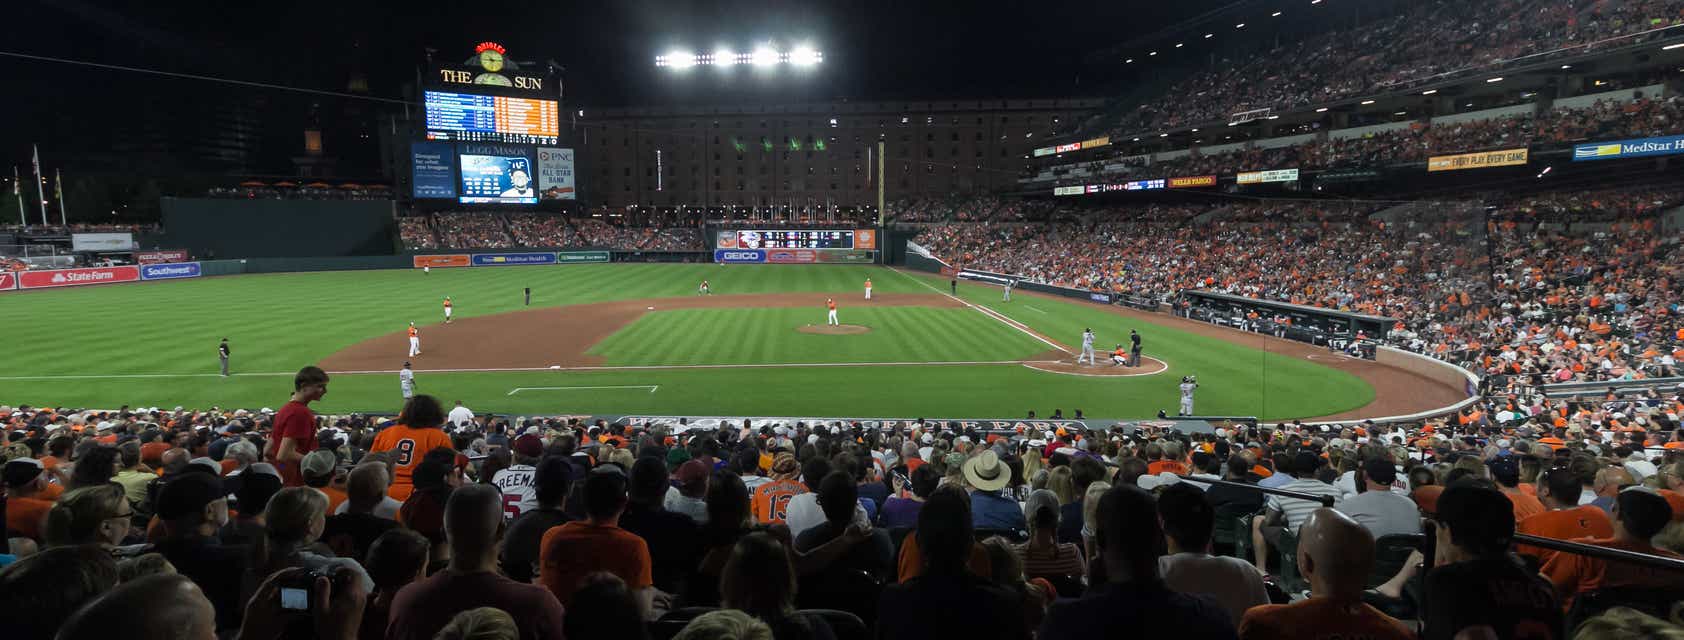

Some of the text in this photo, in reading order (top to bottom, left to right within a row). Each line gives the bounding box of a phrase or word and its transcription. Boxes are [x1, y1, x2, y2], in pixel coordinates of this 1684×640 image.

[440, 69, 542, 90] THE SUN
[1623, 142, 1672, 153] MedStar
[723, 252, 758, 260] GEICO
[147, 266, 190, 276] Southwest
[989, 421, 1079, 431] PARK
[496, 473, 536, 489] REEMA
